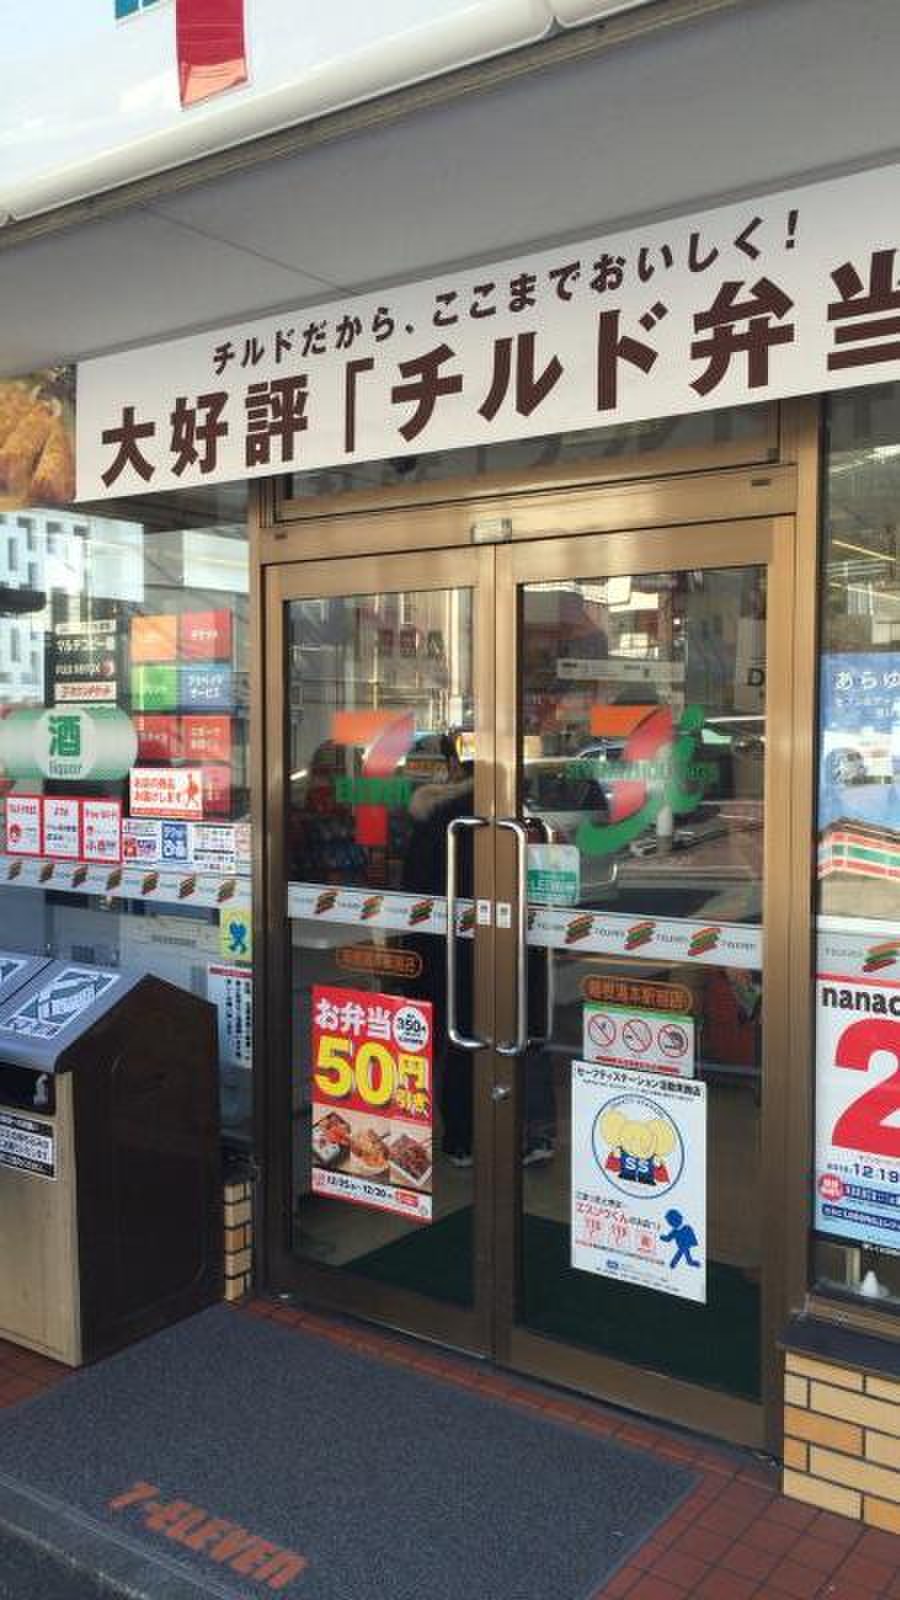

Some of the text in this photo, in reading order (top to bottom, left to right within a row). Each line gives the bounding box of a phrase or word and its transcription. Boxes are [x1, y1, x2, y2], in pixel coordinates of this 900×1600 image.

[49, 715, 81, 758] 酒
[315, 997, 392, 1041] お弁当
[625, 1157, 650, 1173] SS
